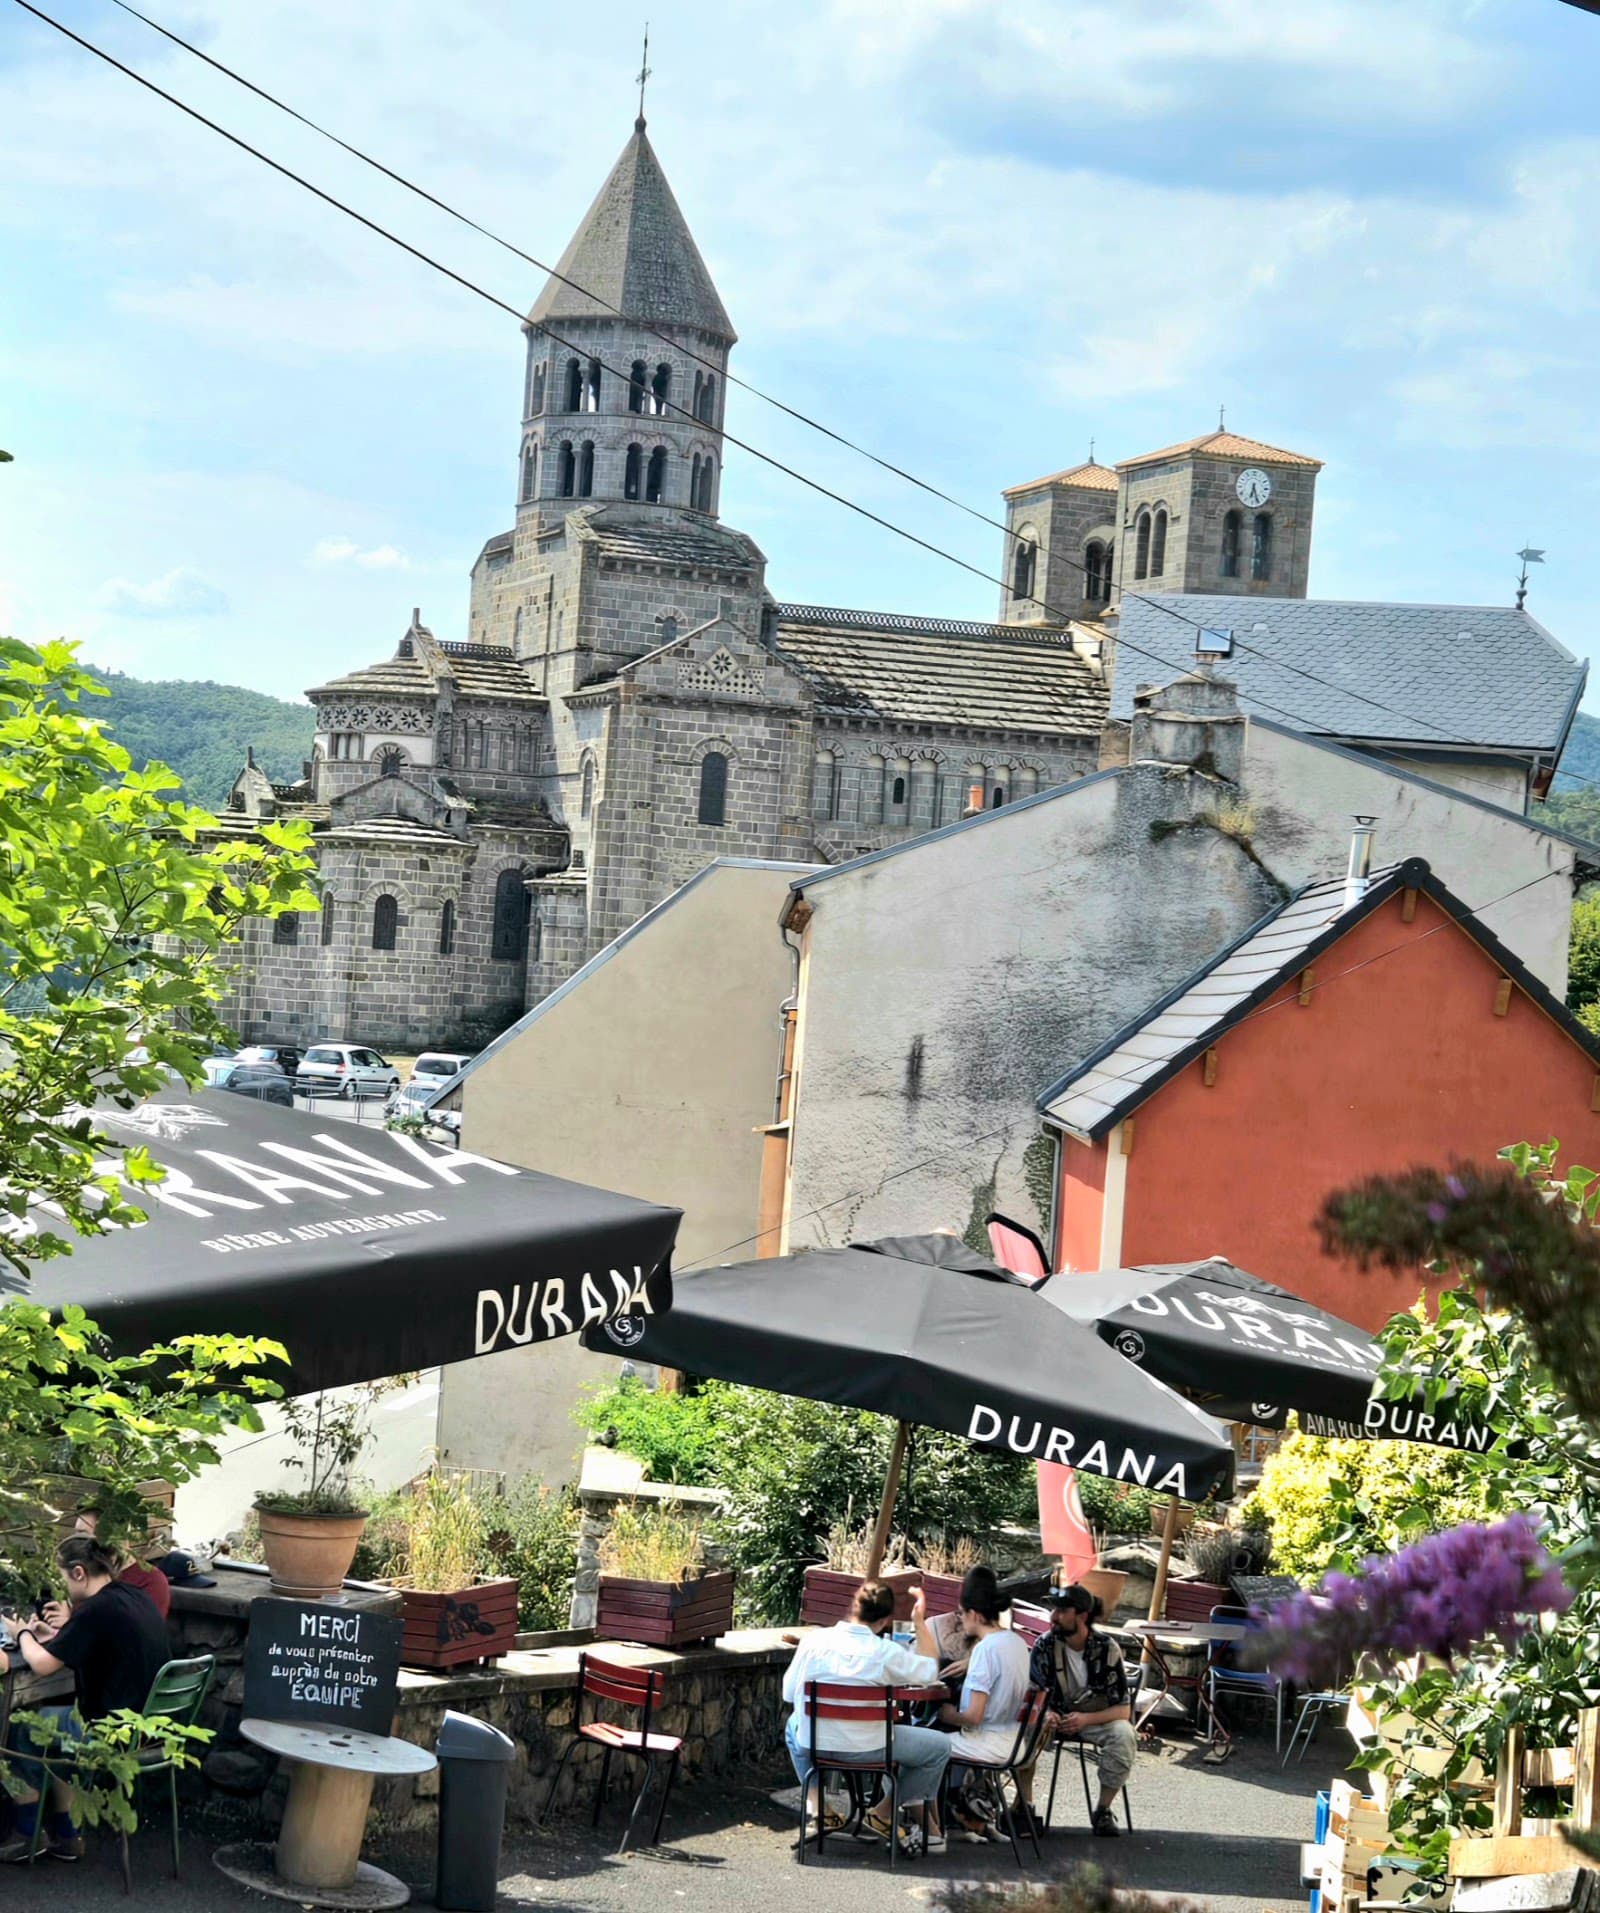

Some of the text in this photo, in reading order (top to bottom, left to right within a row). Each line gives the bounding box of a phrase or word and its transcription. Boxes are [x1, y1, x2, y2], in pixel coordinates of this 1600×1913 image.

[200, 1209, 447, 1253] BIÈRE AUVERGNATE
[1131, 1293, 1386, 1365] DURAN
[1365, 1401, 1489, 1451] DURAN
[968, 1404, 1187, 1497] DURANA
[268, 1643, 374, 1664] de vous présenter
[271, 1661, 378, 1686] auprès de notre
